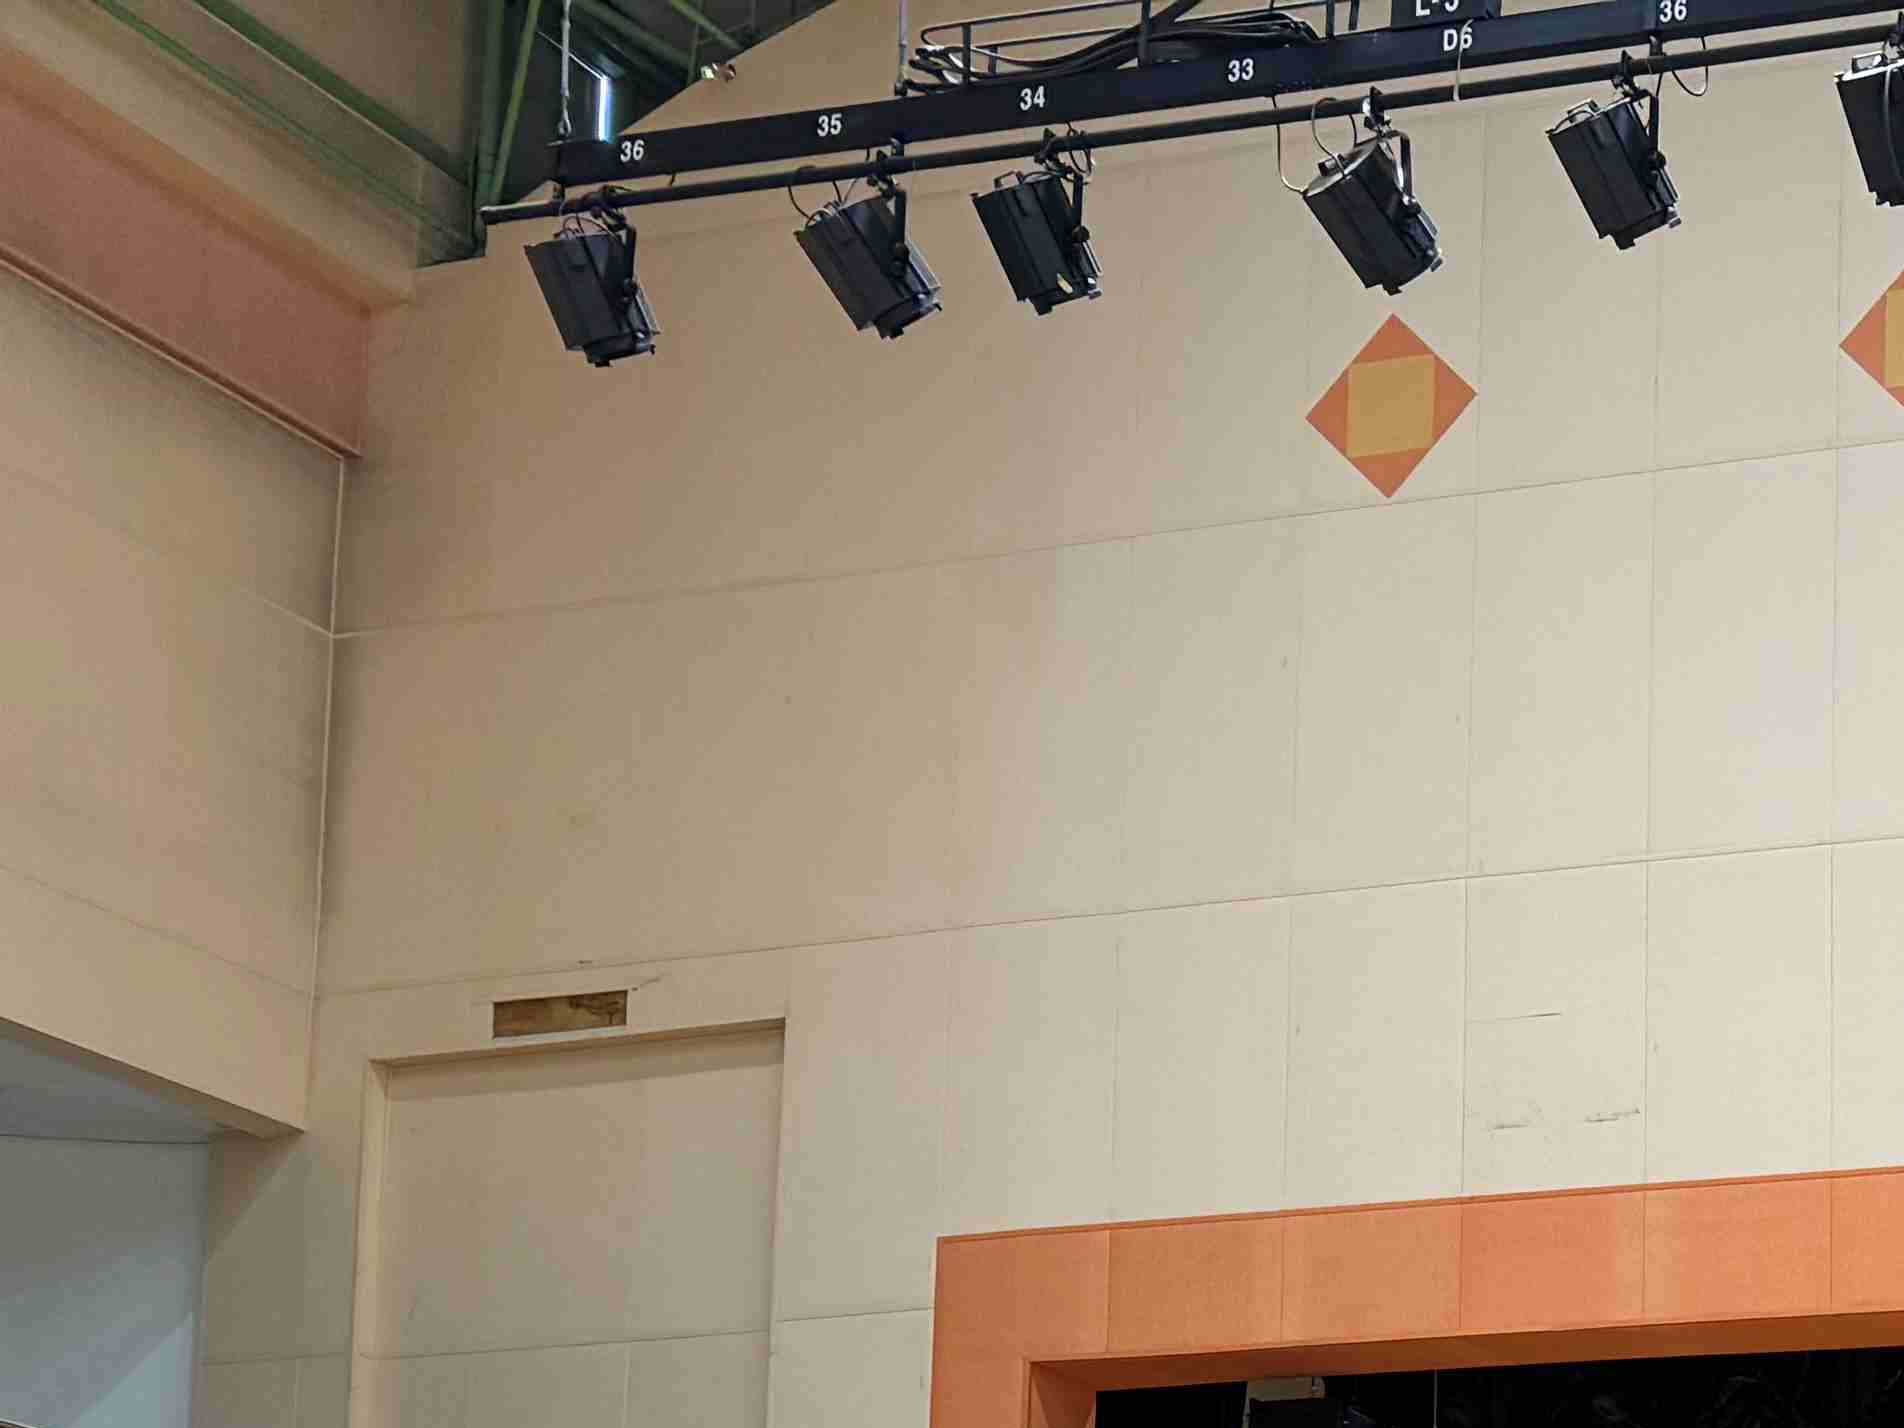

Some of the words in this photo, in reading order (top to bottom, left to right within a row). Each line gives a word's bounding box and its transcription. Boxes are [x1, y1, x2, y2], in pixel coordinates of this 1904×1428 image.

[1659, 0, 1688, 23] 36
[1227, 58, 1255, 83] 33
[1019, 86, 1046, 112] 34
[816, 113, 842, 137] 35
[619, 140, 645, 163] 36
